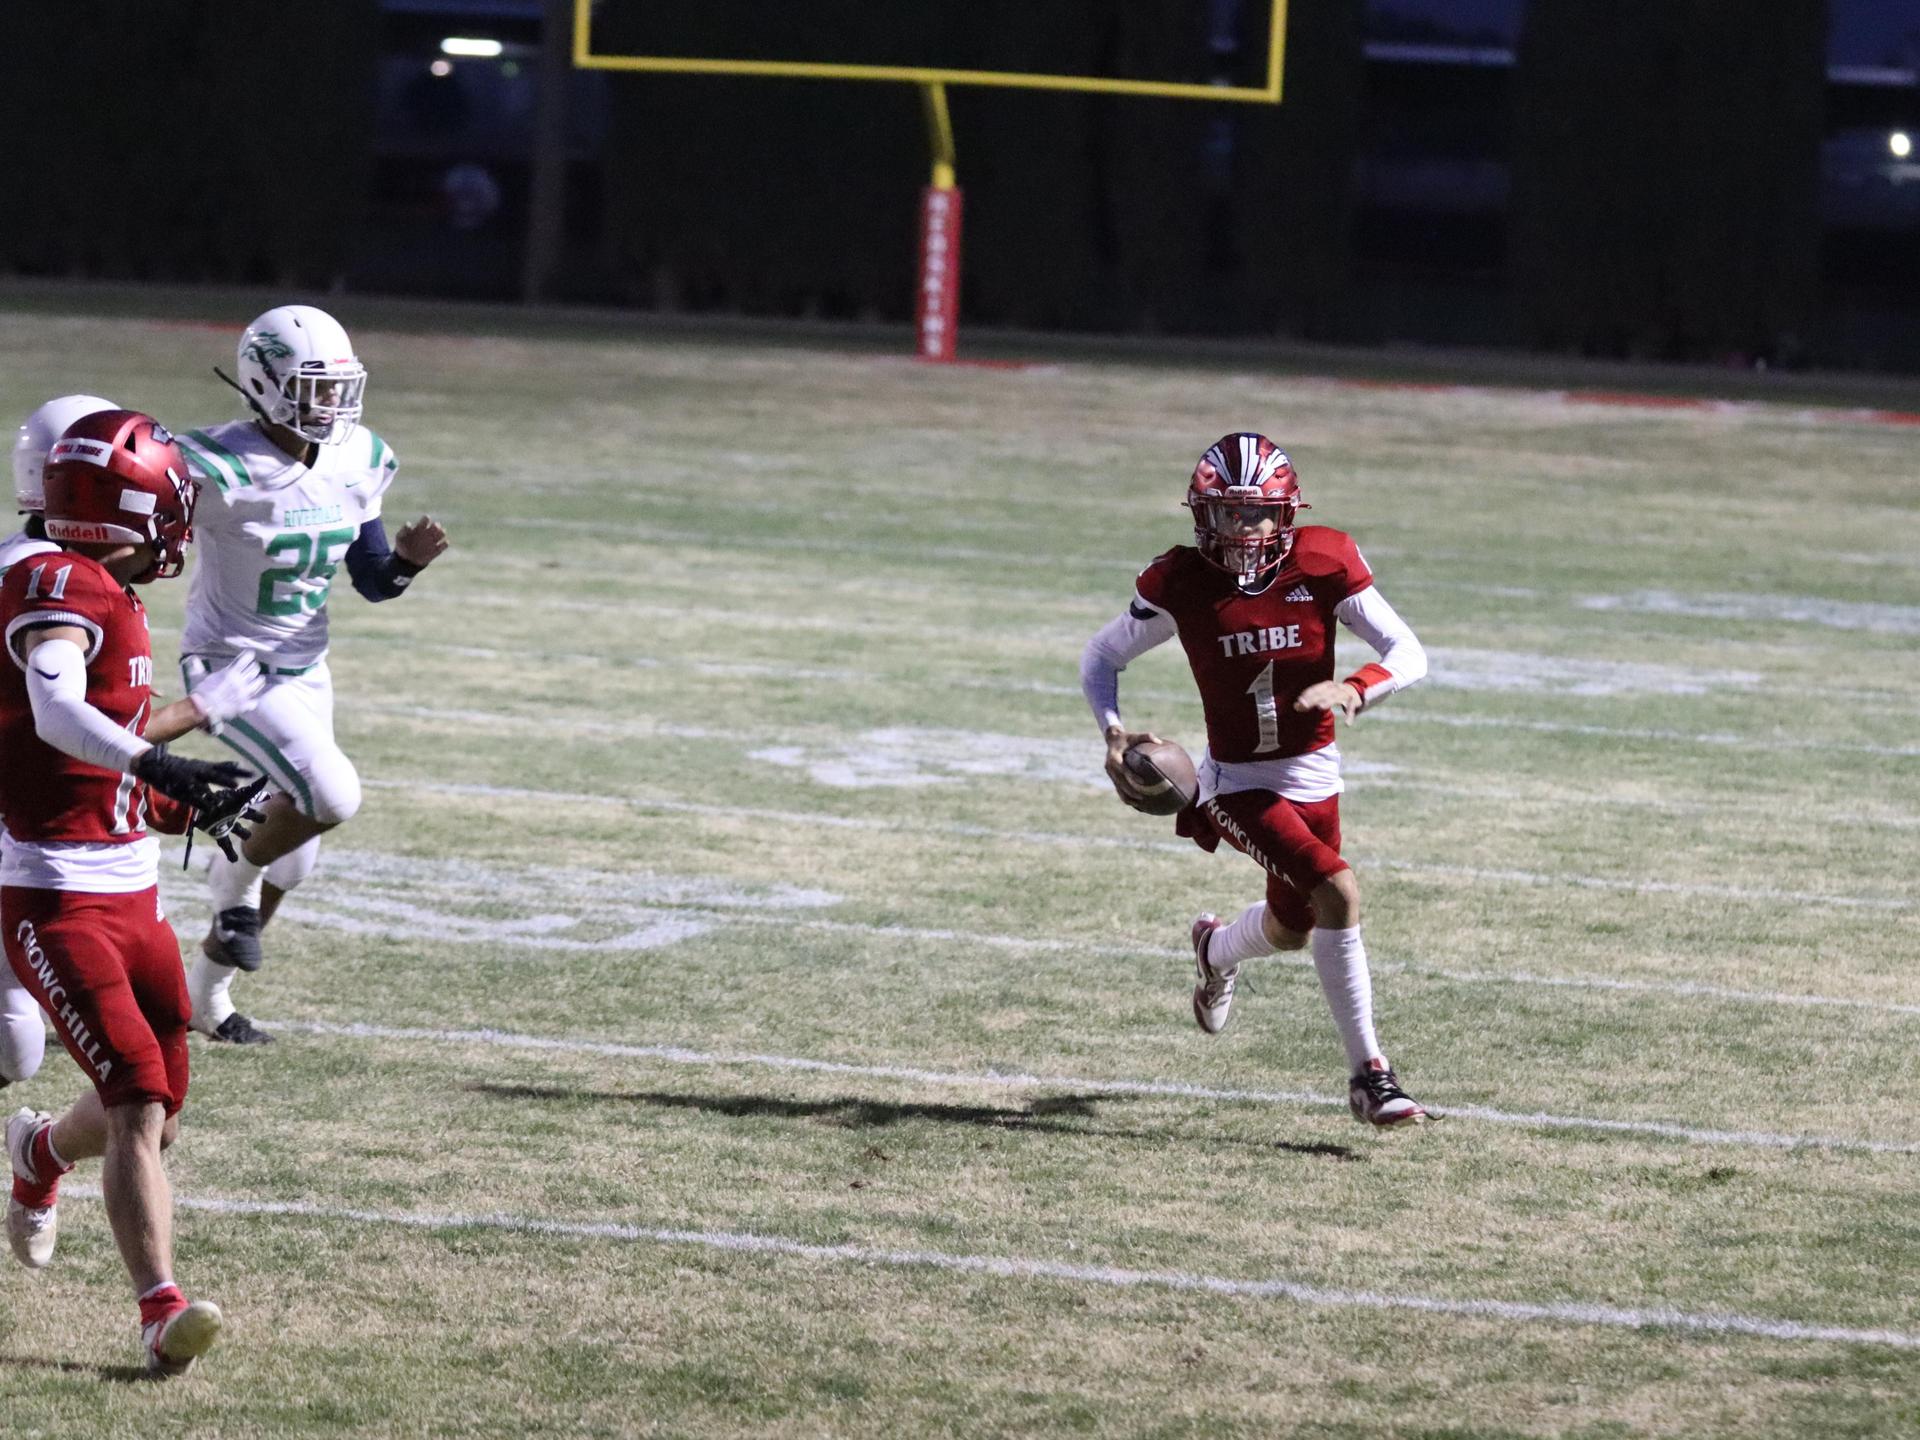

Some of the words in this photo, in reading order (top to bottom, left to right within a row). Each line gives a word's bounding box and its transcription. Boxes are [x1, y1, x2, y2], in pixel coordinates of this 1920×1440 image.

[48, 523, 108, 540] Riddell
[25, 561, 72, 599] 11
[256, 526, 355, 617] 25
[1284, 594, 1313, 602] adidas
[1218, 624, 1302, 658] TRIBE
[1246, 658, 1281, 753] 1
[1207, 798, 1297, 888] HOWCHILLA
[17, 919, 113, 1083] CHOWCHILLA
